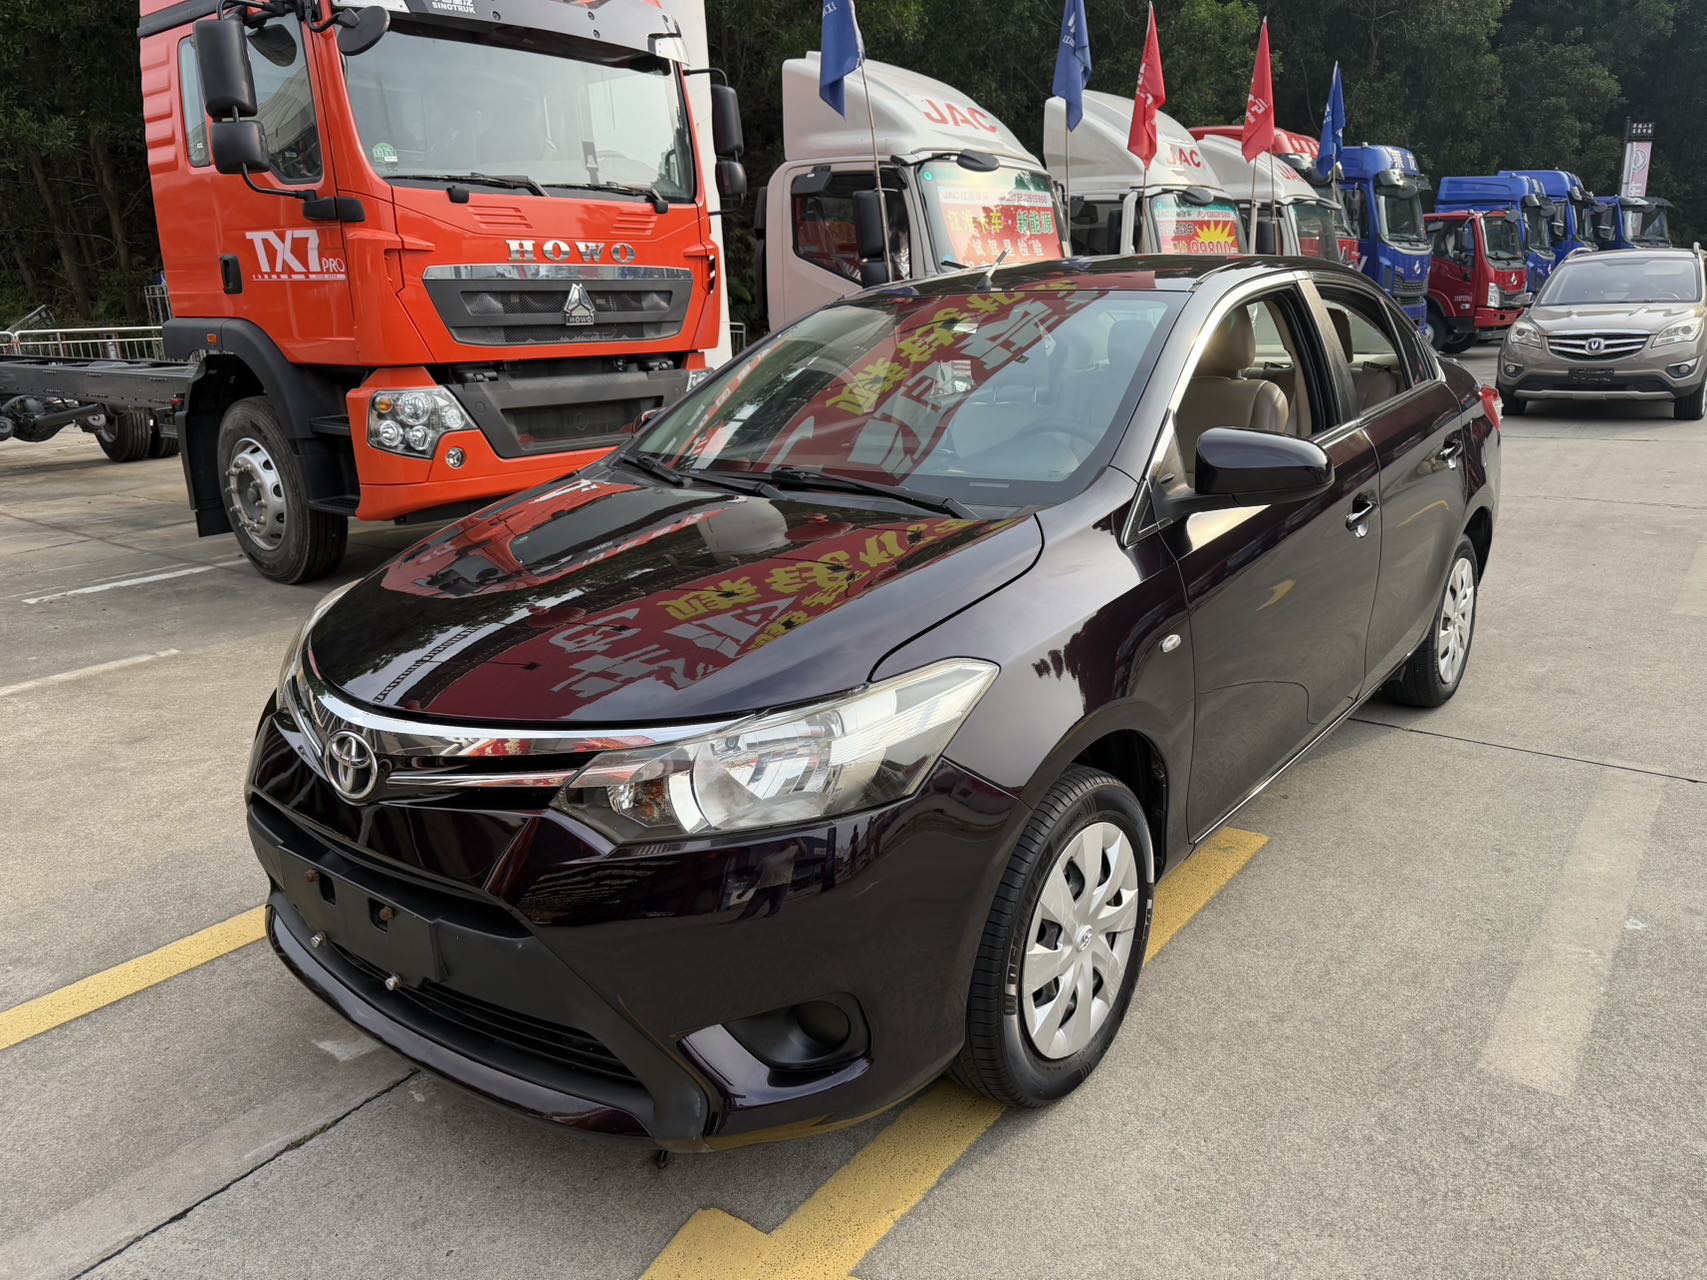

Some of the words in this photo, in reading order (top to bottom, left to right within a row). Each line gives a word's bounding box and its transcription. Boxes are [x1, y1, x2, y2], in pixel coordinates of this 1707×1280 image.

[431, 1, 476, 14] SINOTRUK
[922, 98, 997, 133] JAC
[1166, 144, 1202, 168] JAC
[1016, 210, 1055, 235] 新能源
[245, 229, 322, 273] TX7
[321, 257, 346, 273] PRO
[505, 240, 636, 264] HOWO
